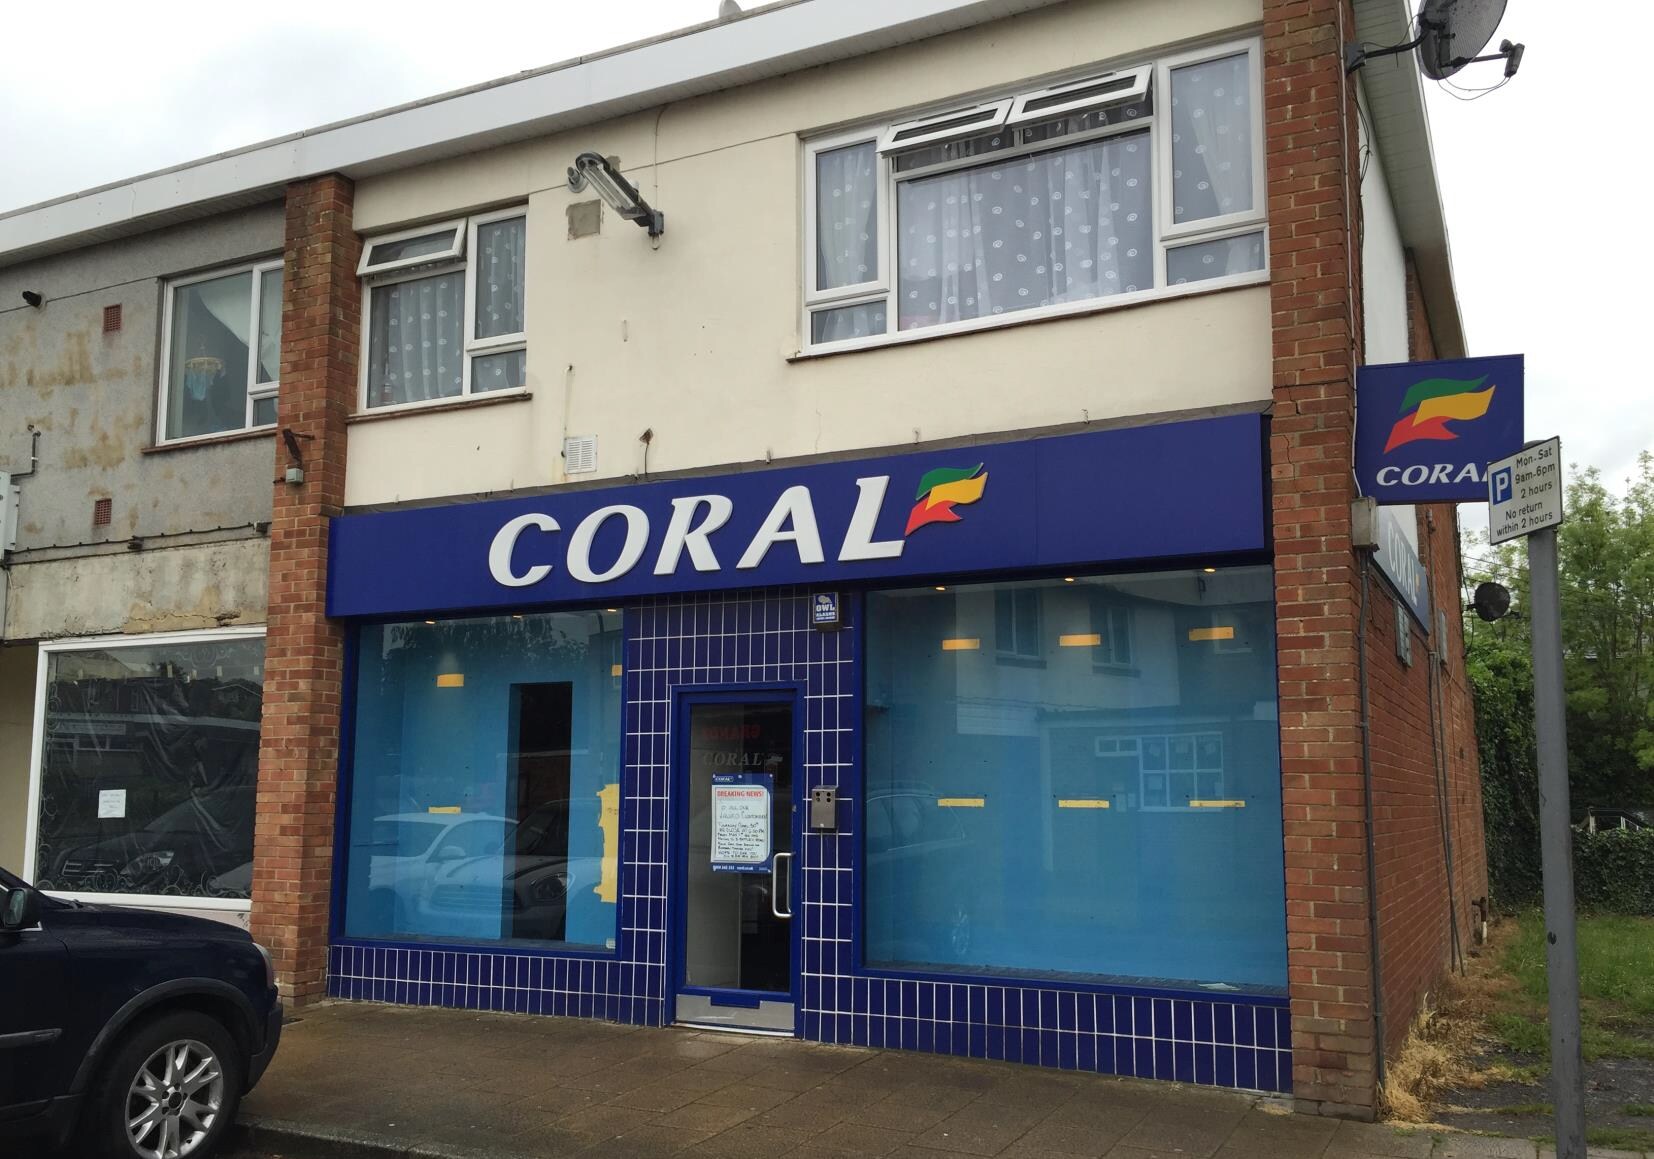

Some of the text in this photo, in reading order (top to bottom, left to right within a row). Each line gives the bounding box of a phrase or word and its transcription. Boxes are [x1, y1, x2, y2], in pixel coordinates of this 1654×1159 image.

[1376, 462, 1489, 486] CORA
[1520, 480, 1553, 499] 2 hours
[1505, 501, 1543, 521] No return
[488, 475, 905, 587] CORAL
[1496, 511, 1553, 537] within 2 hours
[1387, 520, 1418, 607] CORAL
[703, 752, 762, 767] CORAL
